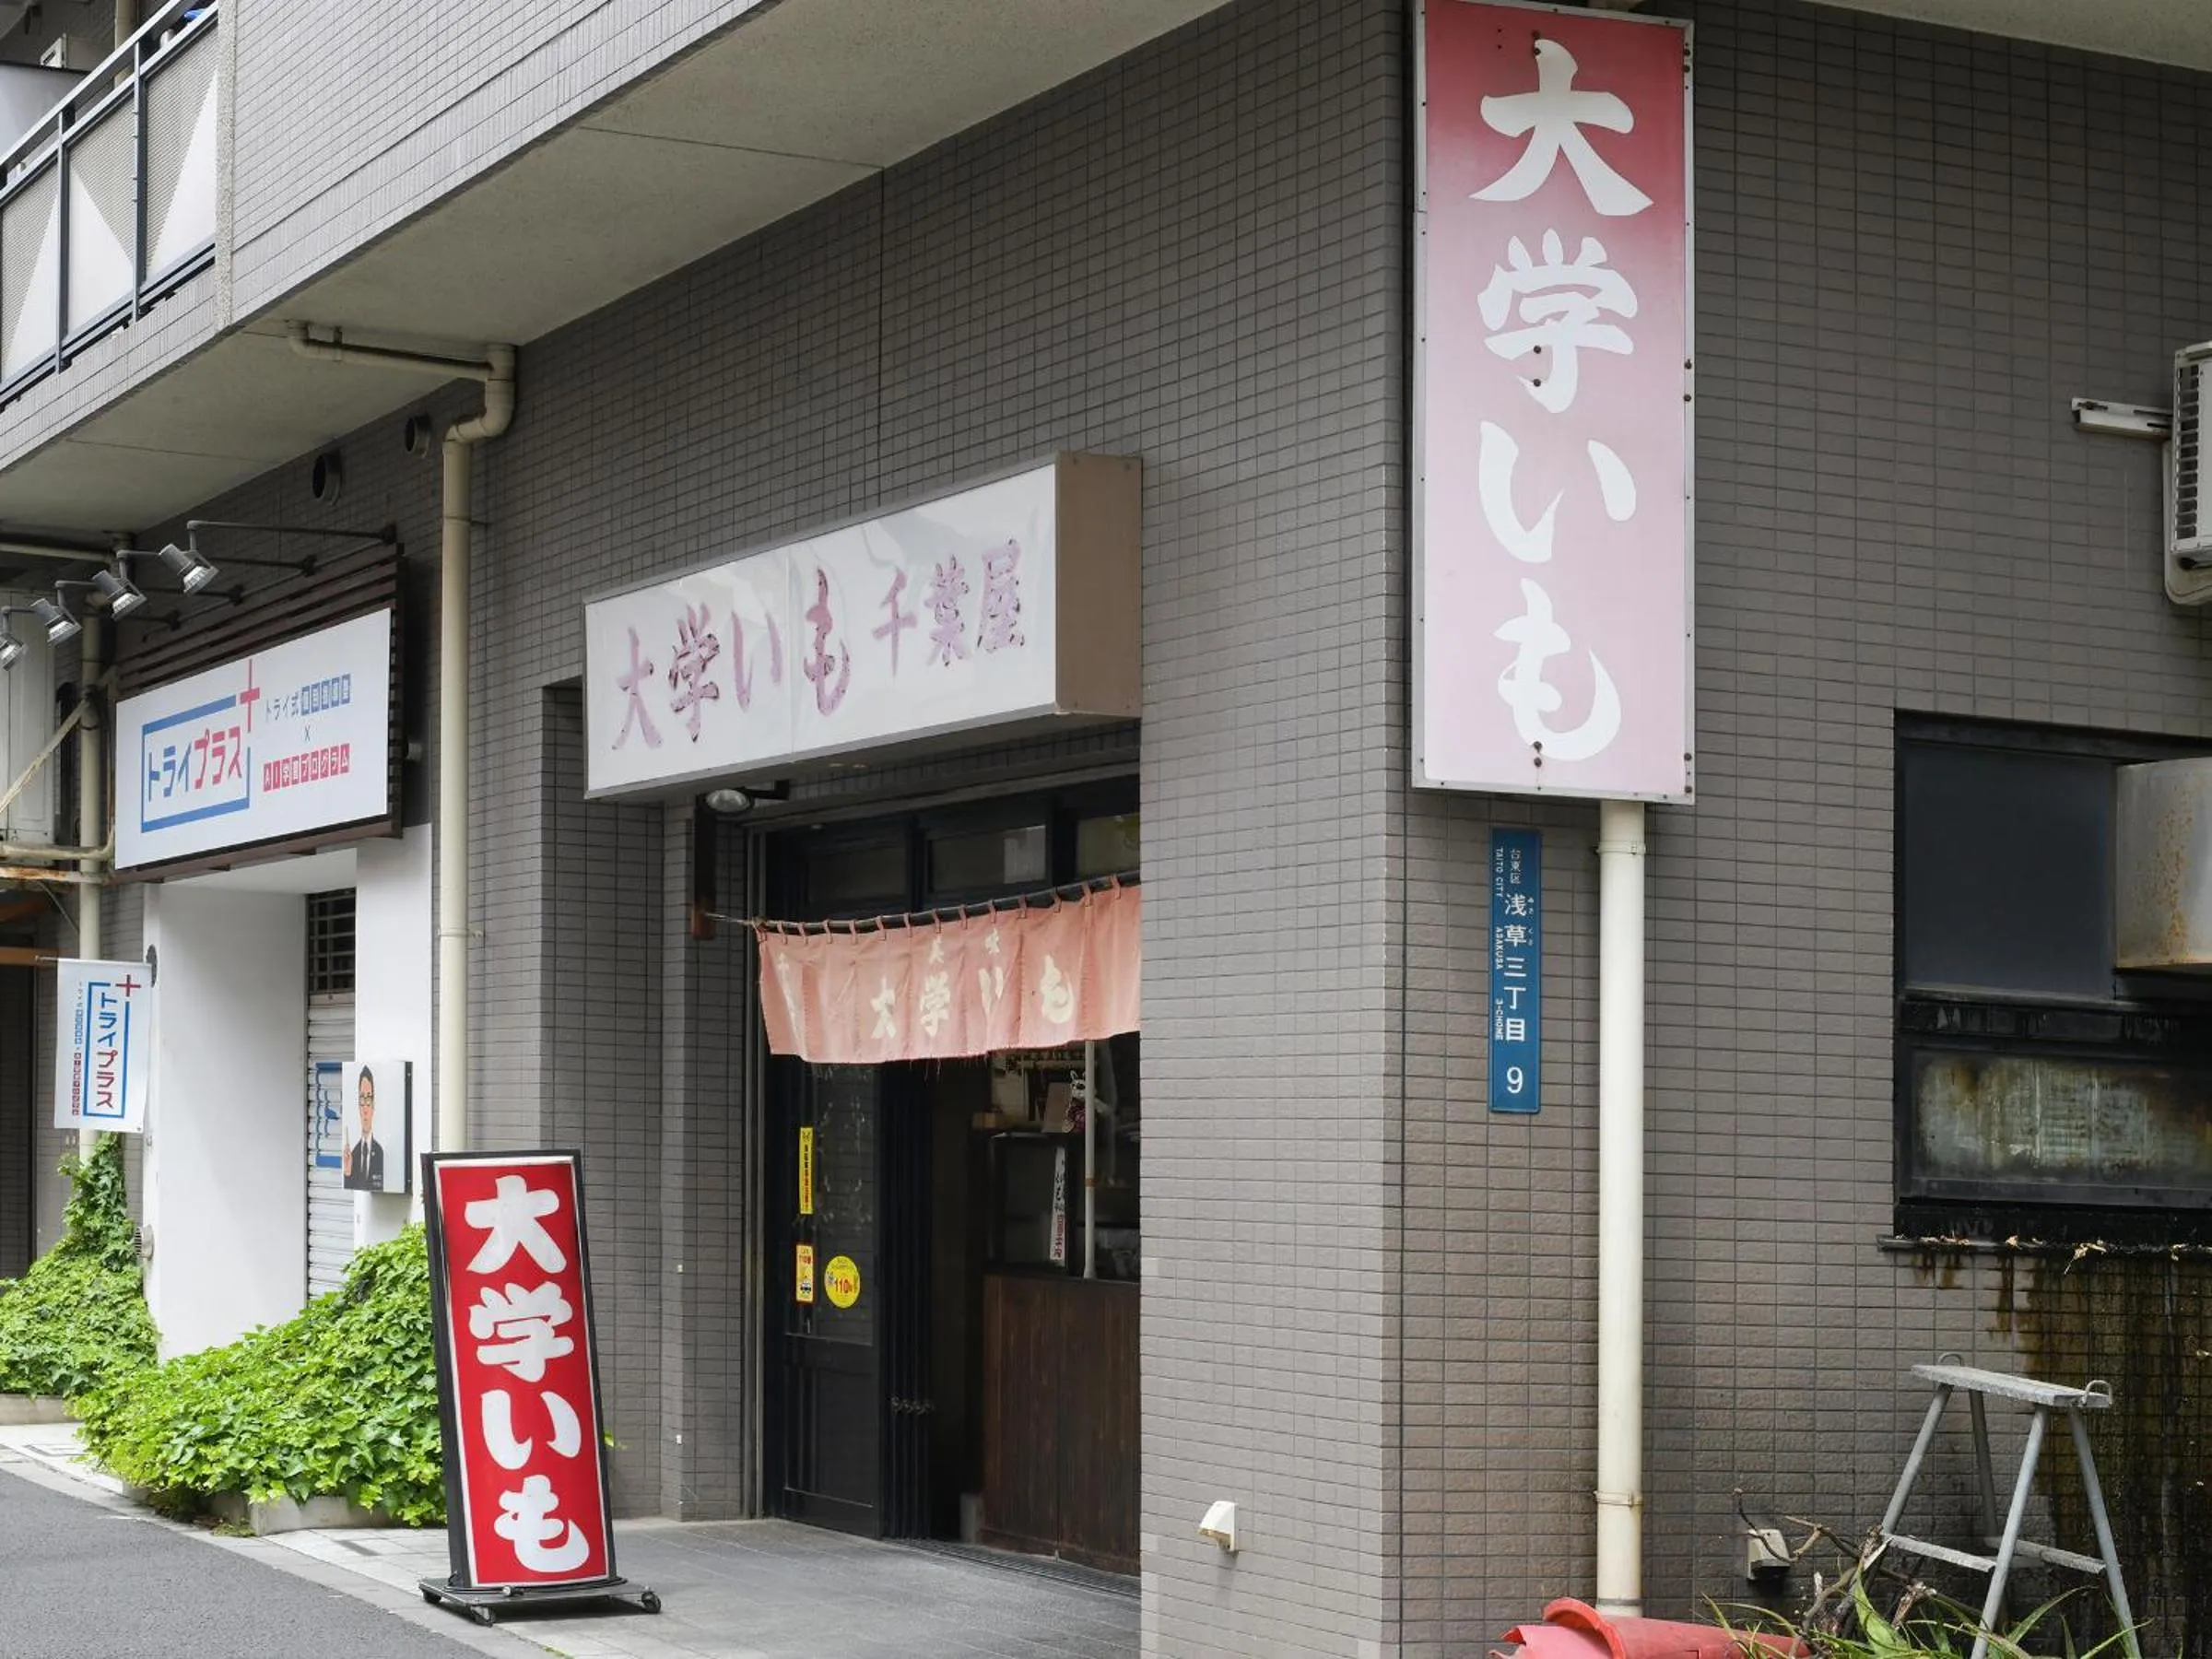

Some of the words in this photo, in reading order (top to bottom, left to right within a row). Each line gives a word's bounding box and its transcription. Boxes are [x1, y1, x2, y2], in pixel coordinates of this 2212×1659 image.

[1469, 40, 1653, 760] 大学いも
[612, 567, 851, 752] 大学いも
[871, 538, 1026, 677] 千葉屋
[147, 725, 242, 803] トライプラス
[1496, 877, 1504, 898] CITY
[869, 953, 1075, 1039] 大学いも
[1495, 926, 1504, 970] ASAKUSA
[1503, 892, 1528, 1042] 浅草三丁目
[96, 992, 119, 1110] トライプラス
[1506, 1065, 1524, 1094] 9
[464, 1175, 590, 1572] 大学いも
